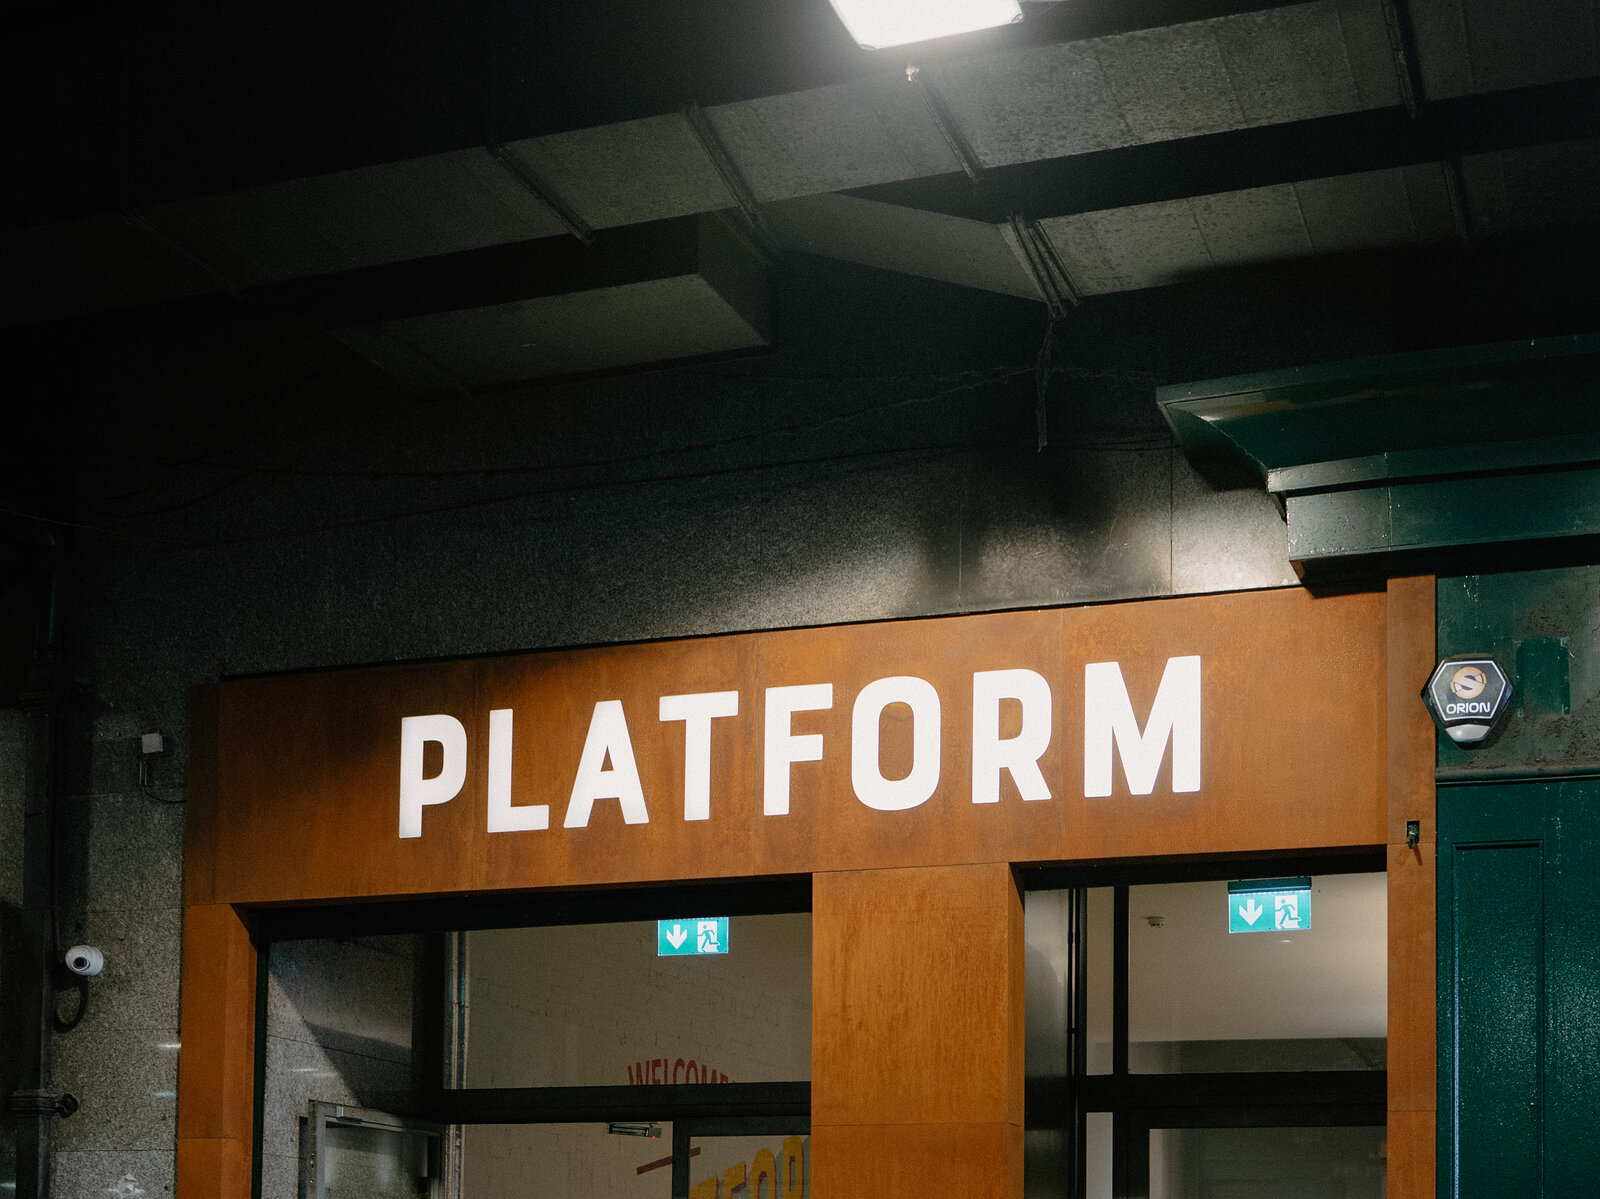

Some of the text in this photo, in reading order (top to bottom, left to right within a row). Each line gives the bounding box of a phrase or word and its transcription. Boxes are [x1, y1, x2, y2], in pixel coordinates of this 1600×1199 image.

[1446, 702, 1491, 714] ORION
[399, 655, 1201, 838] PLATFORM
[627, 1058, 729, 1085] WELCO
